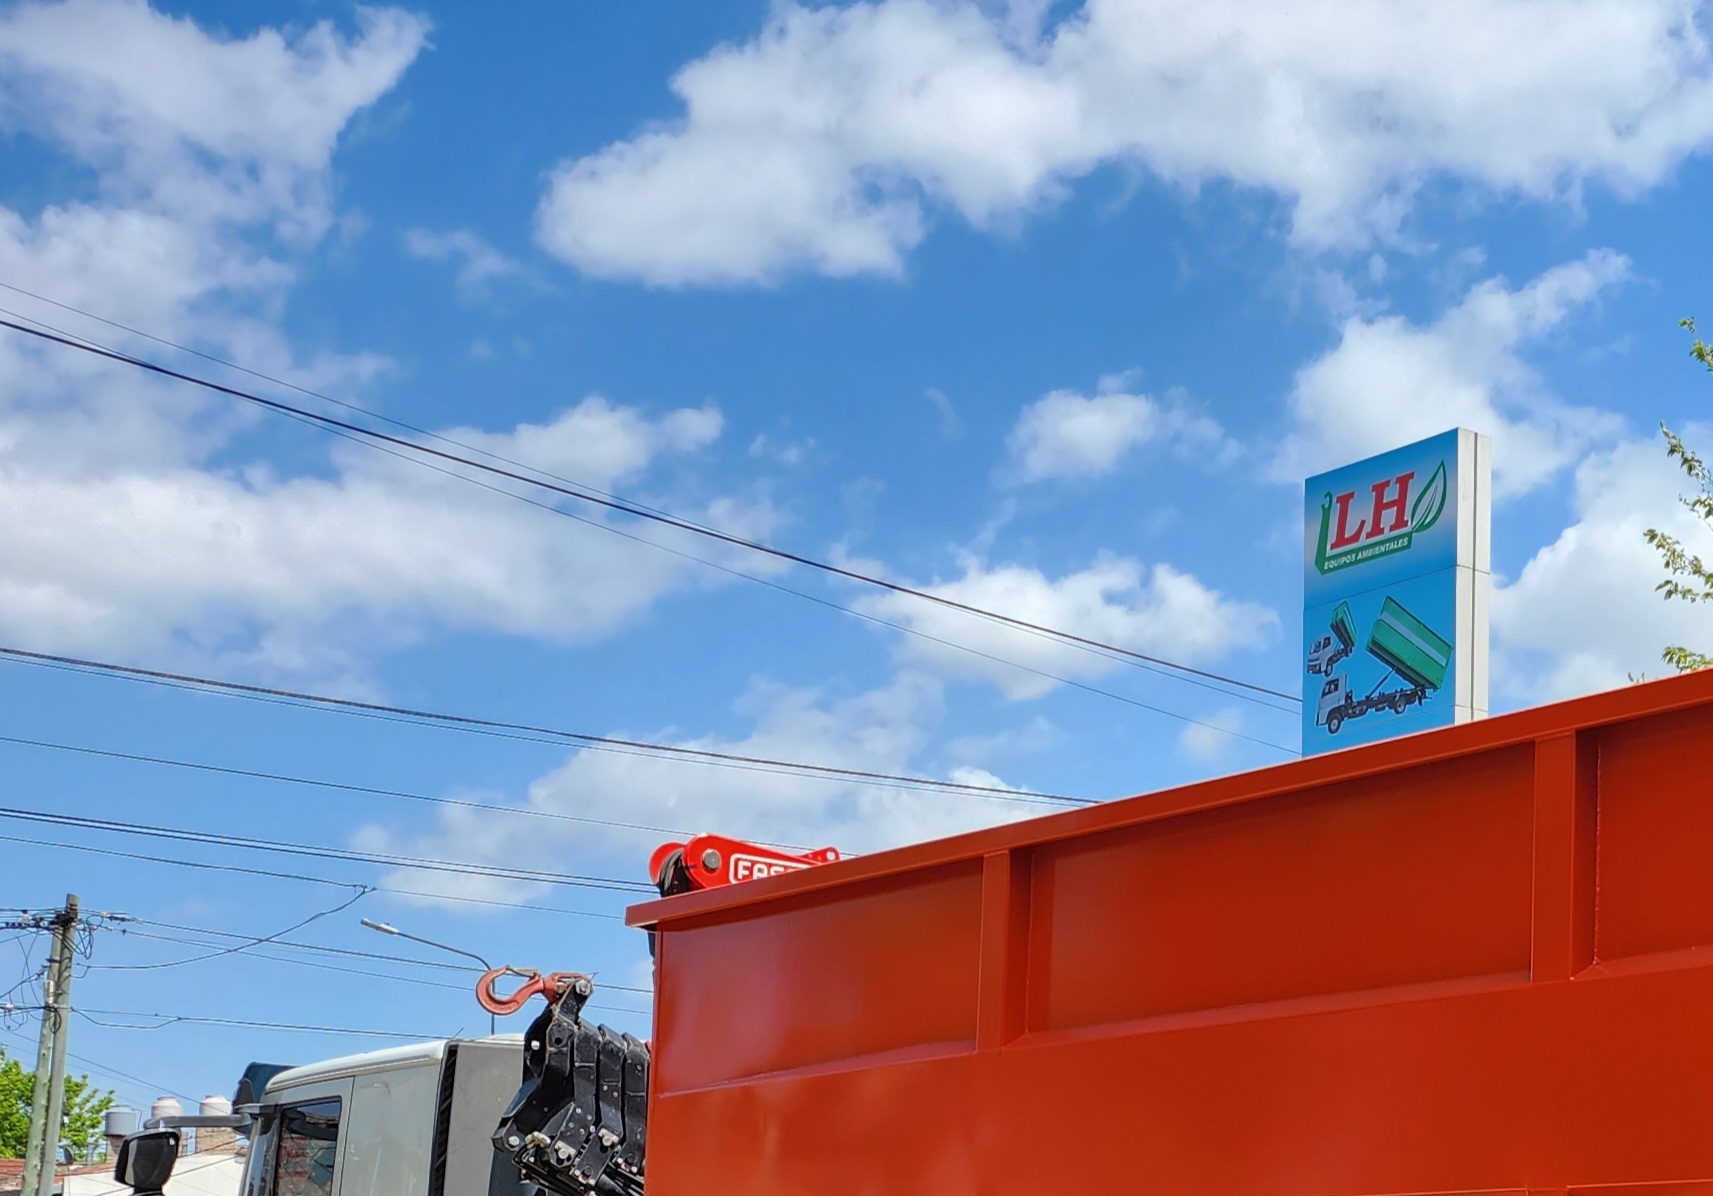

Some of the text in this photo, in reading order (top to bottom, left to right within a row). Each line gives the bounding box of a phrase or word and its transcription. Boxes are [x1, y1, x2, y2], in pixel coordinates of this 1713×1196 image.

[1330, 471, 1415, 550] LH
[1323, 537, 1408, 570] EQUIPOS AMBIENTALES
